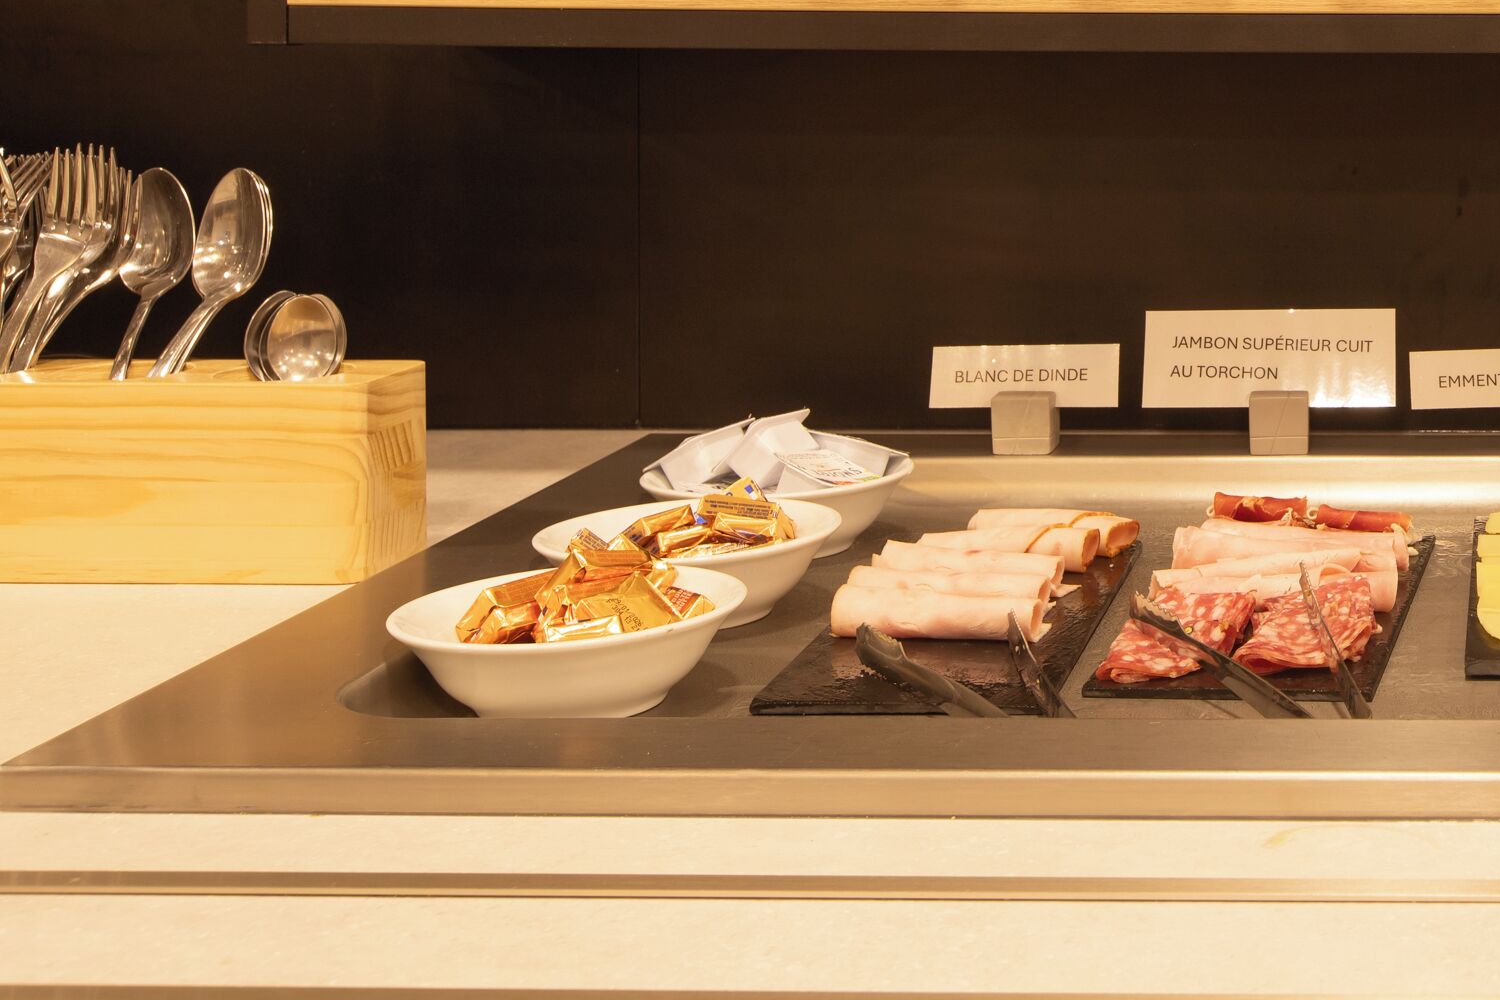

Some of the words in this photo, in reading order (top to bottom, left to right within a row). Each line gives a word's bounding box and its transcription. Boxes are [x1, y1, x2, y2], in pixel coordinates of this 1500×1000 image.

[1171, 335, 1239, 350] JAMBON
[1241, 334, 1331, 353] SUPÉRIEUR
[1335, 339, 1374, 353] CUIT
[954, 369, 1009, 384] BLANC
[1012, 368, 1035, 383] DE
[1038, 367, 1089, 382] DINDE
[1169, 364, 1193, 378] AU
[1196, 364, 1279, 380] TORCHON
